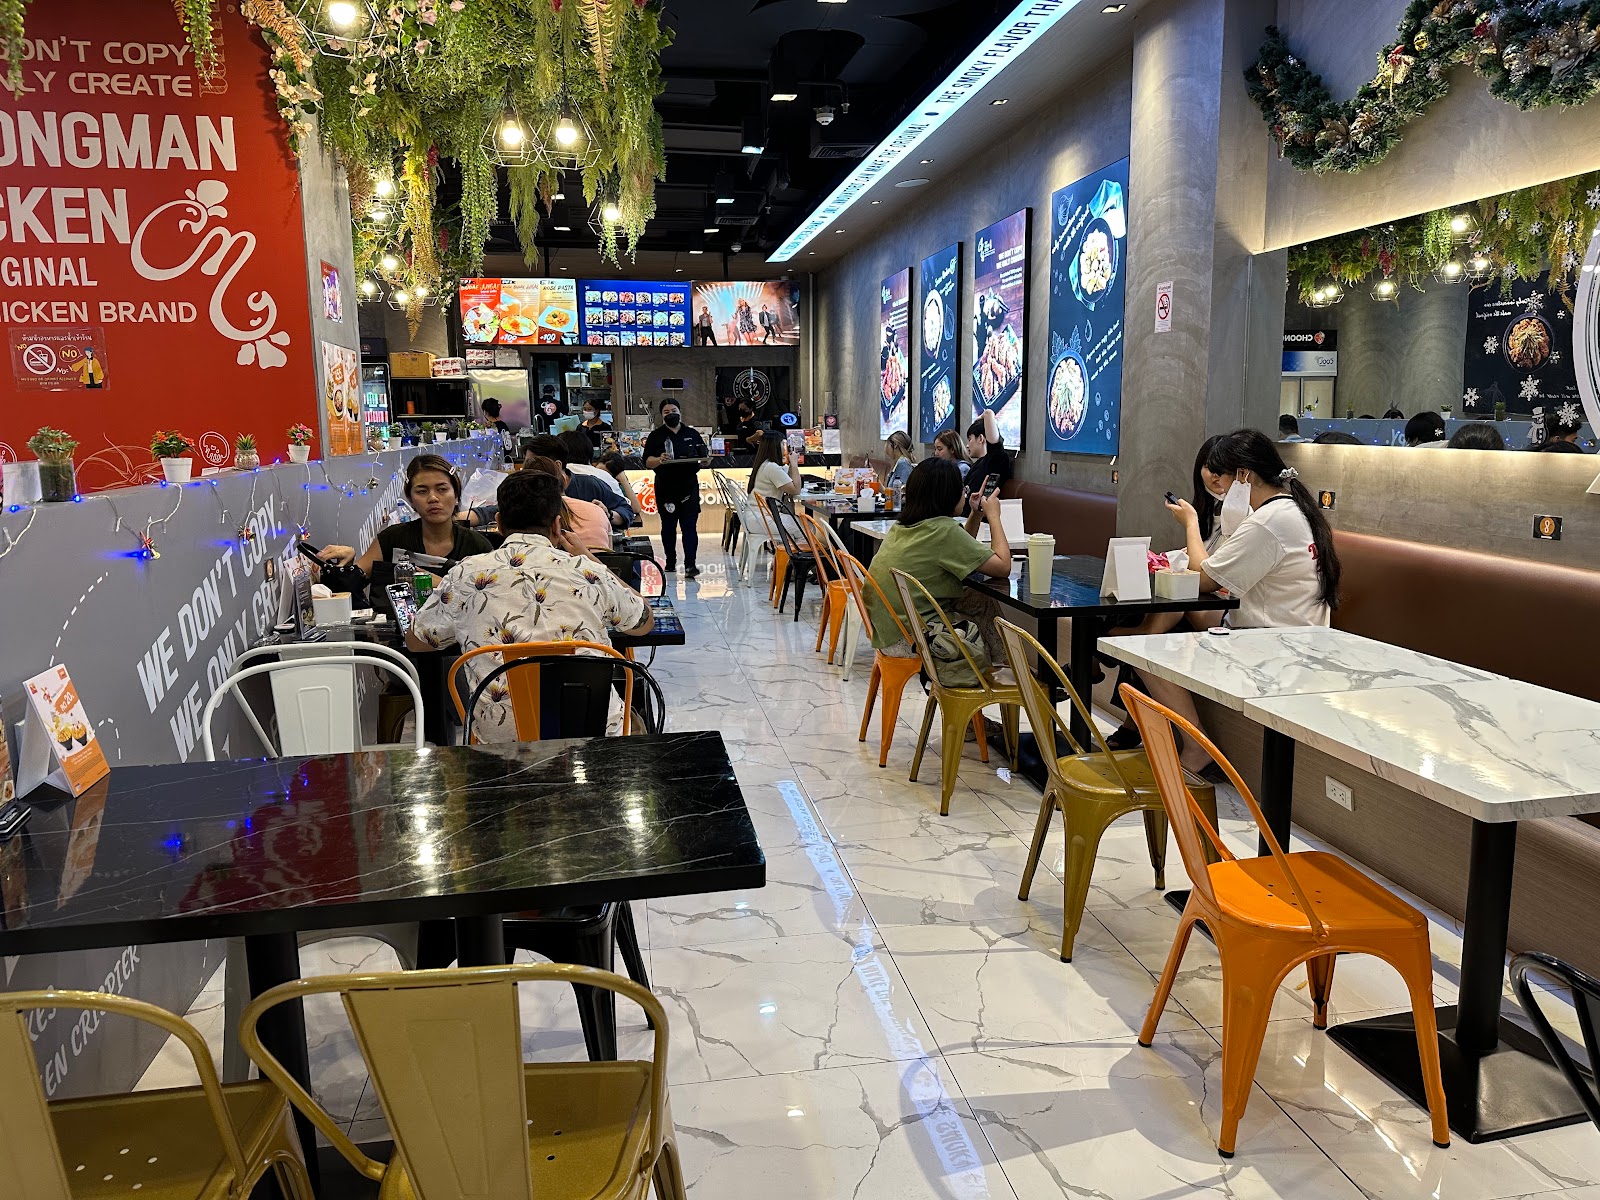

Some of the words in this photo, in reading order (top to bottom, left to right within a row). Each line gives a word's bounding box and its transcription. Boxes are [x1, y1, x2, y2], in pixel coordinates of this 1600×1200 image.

[103, 41, 191, 66] COPY
[935, 91, 965, 103] THE
[952, 60, 997, 89] SMOKY
[983, 22, 1041, 58] FLAVOR
[68, 72, 193, 97] CREATE
[890, 123, 930, 148] ORIGINAL
[0, 187, 131, 244] KEN
[0, 257, 98, 287] GINAL
[0, 301, 88, 323] ICKEN
[100, 301, 197, 323] BRAND
[62, 350, 78, 358] NO
[136, 626, 179, 714] WE
[177, 546, 238, 663] DON'T
[239, 493, 283, 578] COPY.
